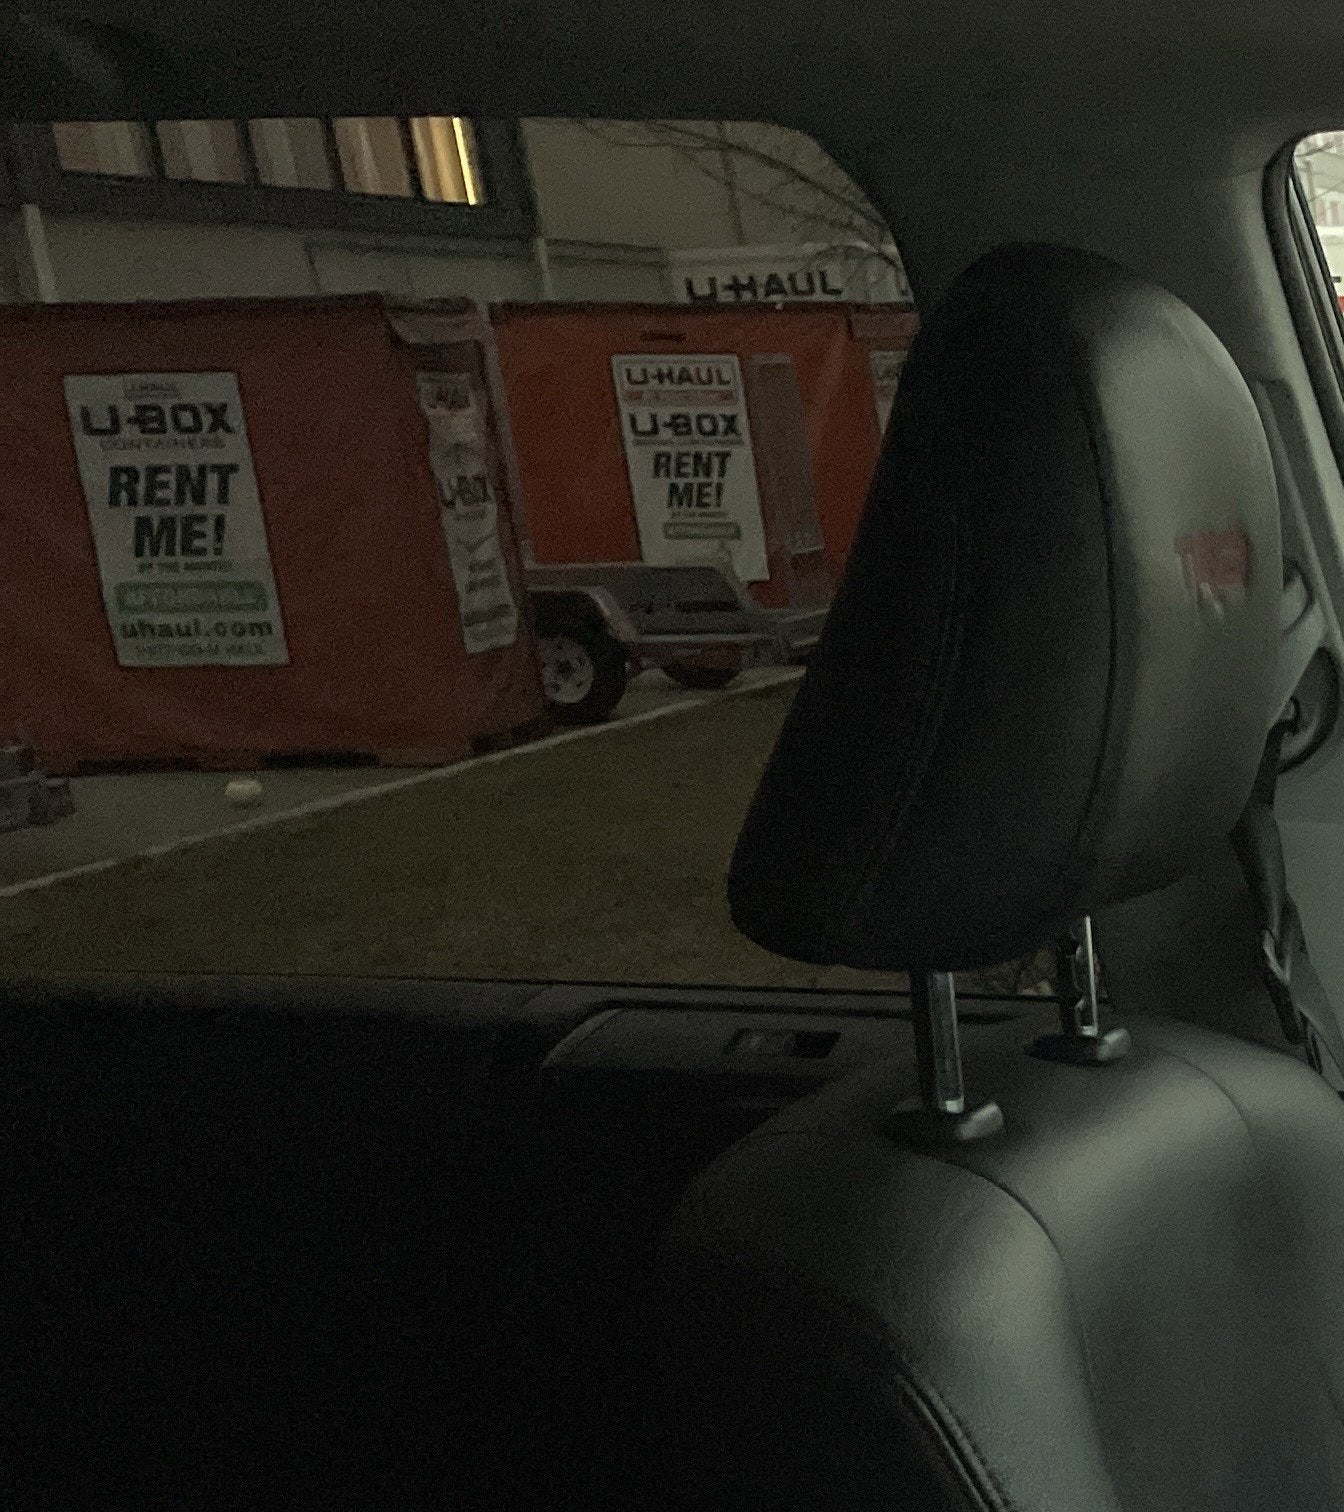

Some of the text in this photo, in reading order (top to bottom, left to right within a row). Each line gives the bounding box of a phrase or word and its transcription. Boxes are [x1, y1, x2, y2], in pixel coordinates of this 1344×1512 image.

[683, 269, 843, 302] U-HAUL
[625, 365, 733, 386] U-HAUL
[80, 402, 236, 437] U-BOX
[629, 412, 742, 438] U-BOX
[652, 451, 731, 480] RENT
[107, 463, 240, 508] RENT
[667, 481, 724, 509] ME!
[133, 514, 226, 558] ME!
[121, 619, 273, 639] uhaul.com
